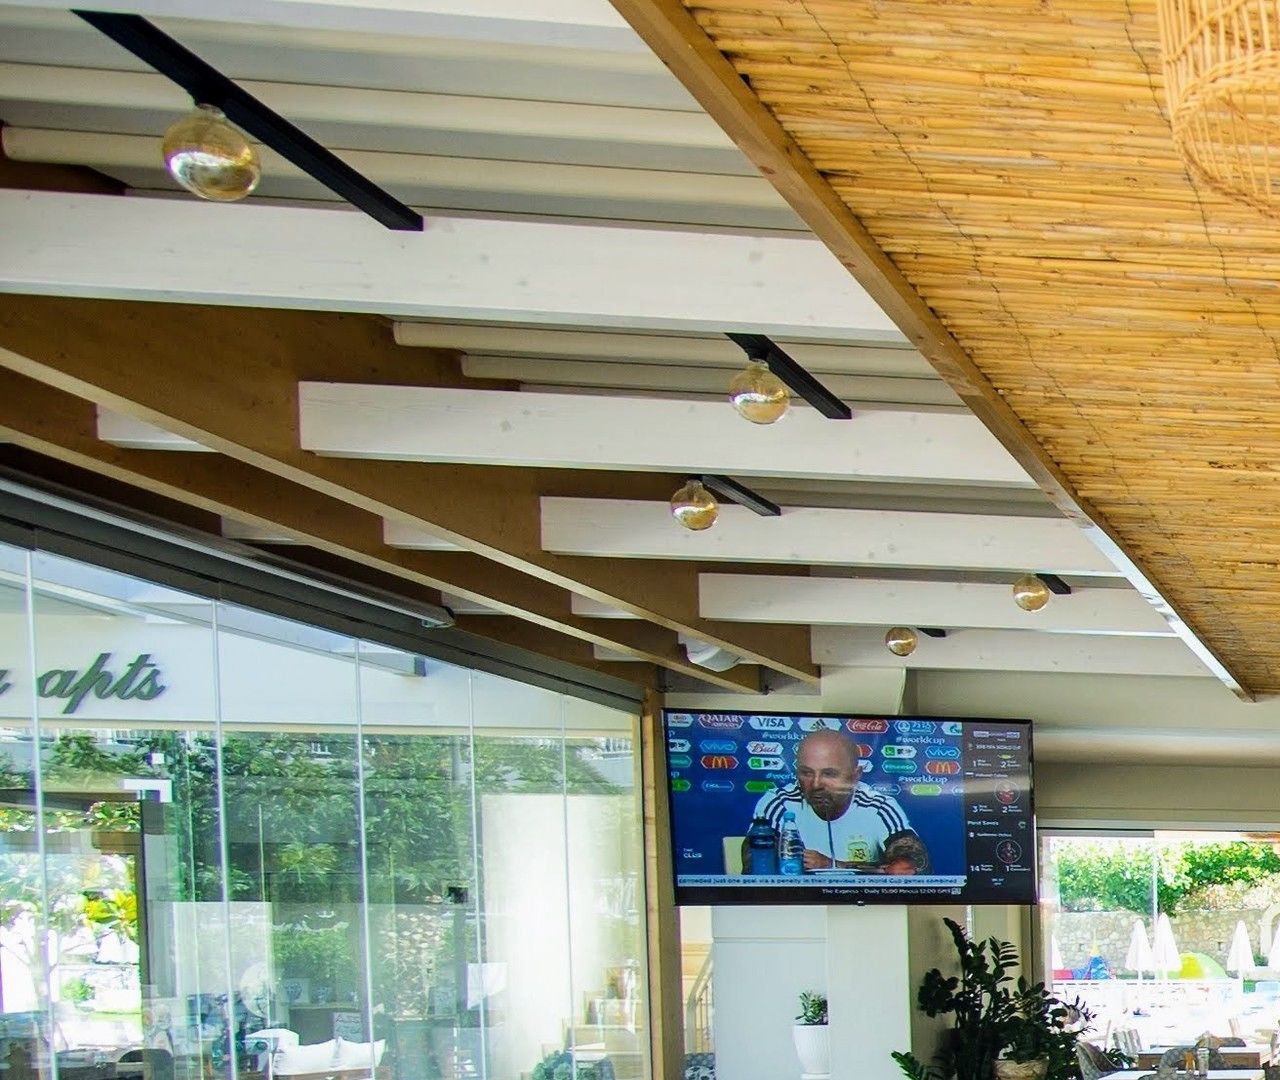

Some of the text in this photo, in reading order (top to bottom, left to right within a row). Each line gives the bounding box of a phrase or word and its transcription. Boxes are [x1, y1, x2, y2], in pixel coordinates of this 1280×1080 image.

[37, 652, 166, 714] apts
[757, 717, 786, 728] VISA
[751, 742, 781, 753] Bud
